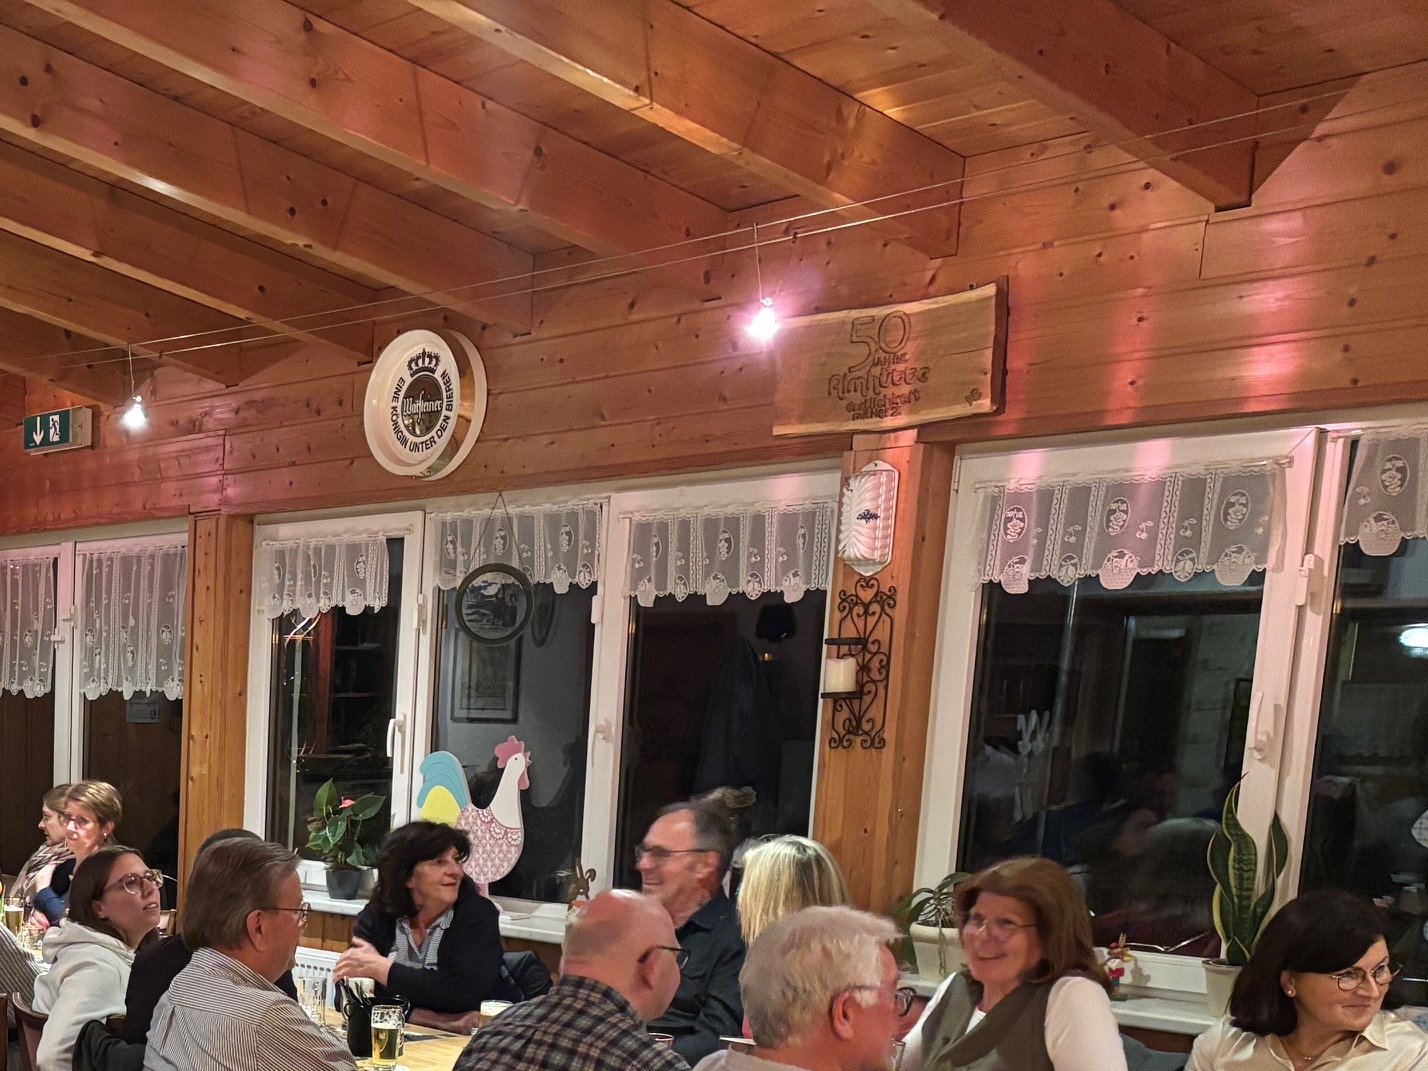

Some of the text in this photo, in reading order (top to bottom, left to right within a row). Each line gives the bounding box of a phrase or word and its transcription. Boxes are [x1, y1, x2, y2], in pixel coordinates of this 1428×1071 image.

[848, 310, 911, 374] 50
[391, 369, 453, 453] EINE KÖNIGIN UNTER DEN BIEREN
